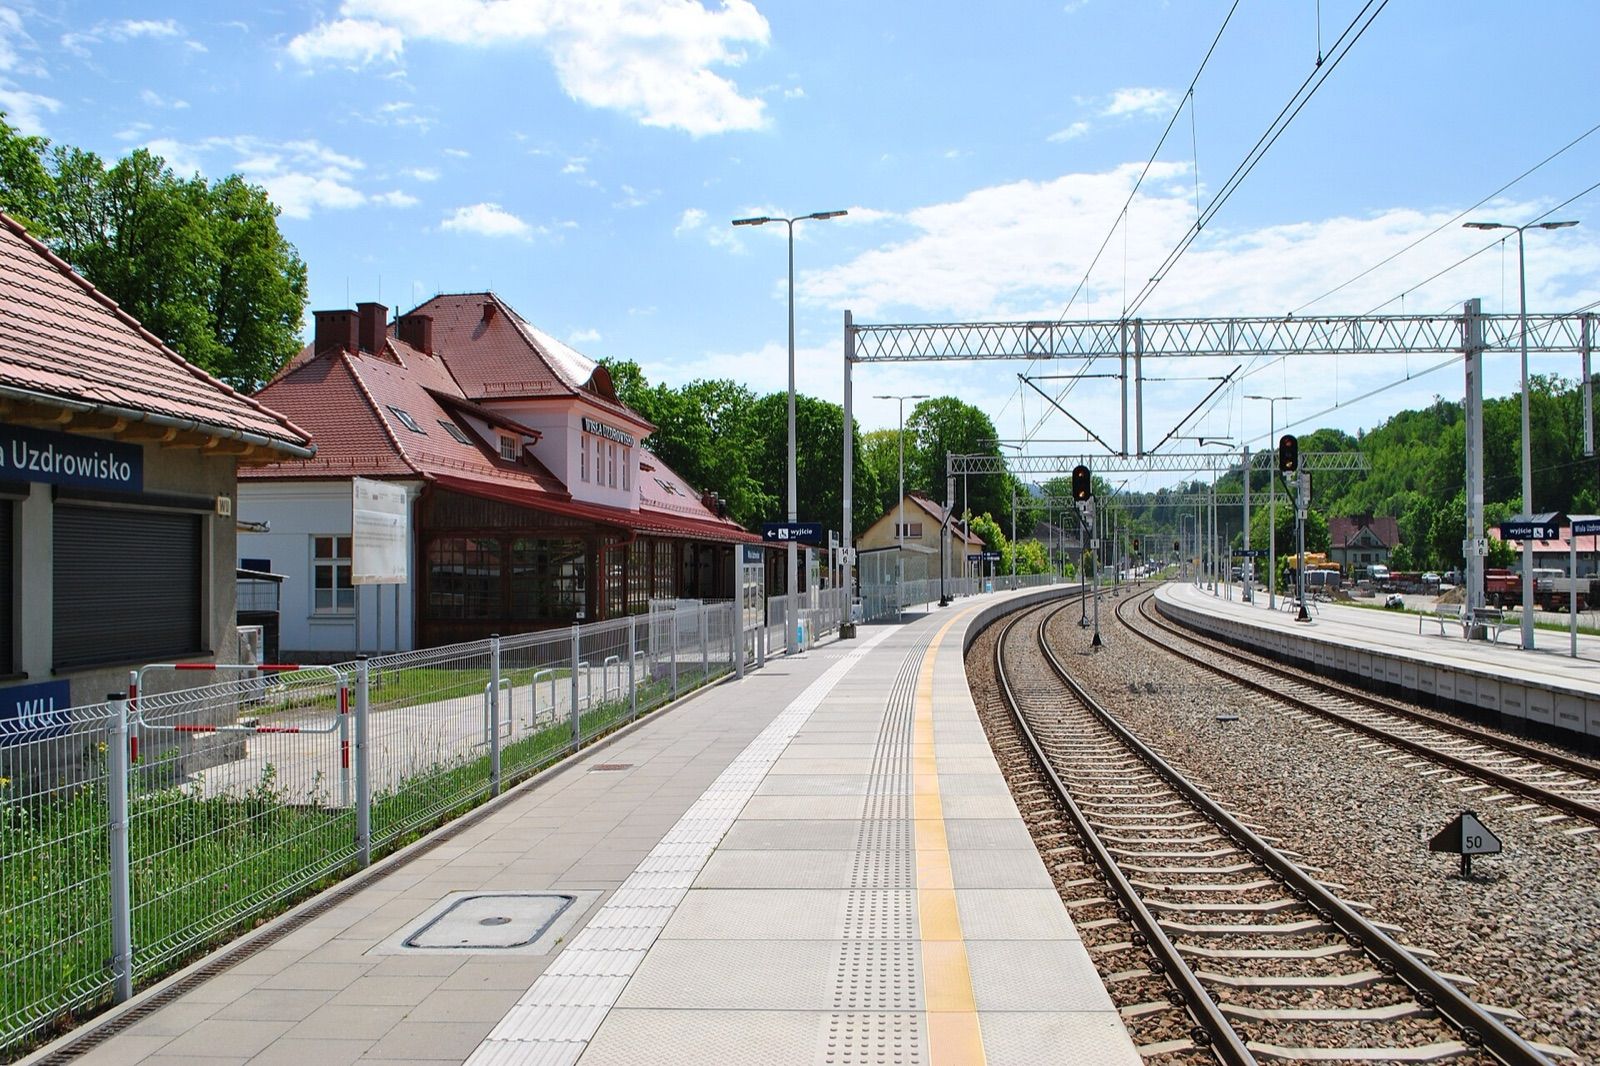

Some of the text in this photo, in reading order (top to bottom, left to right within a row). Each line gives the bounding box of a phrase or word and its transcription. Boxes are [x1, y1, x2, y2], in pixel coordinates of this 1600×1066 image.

[12, 439, 131, 482] Uzdrowisko
[1477, 539, 1485, 547] 14
[842, 548, 849, 556] 14
[843, 556, 848, 564] 6
[16, 697, 54, 729] WU
[1466, 835, 1483, 849] 50
